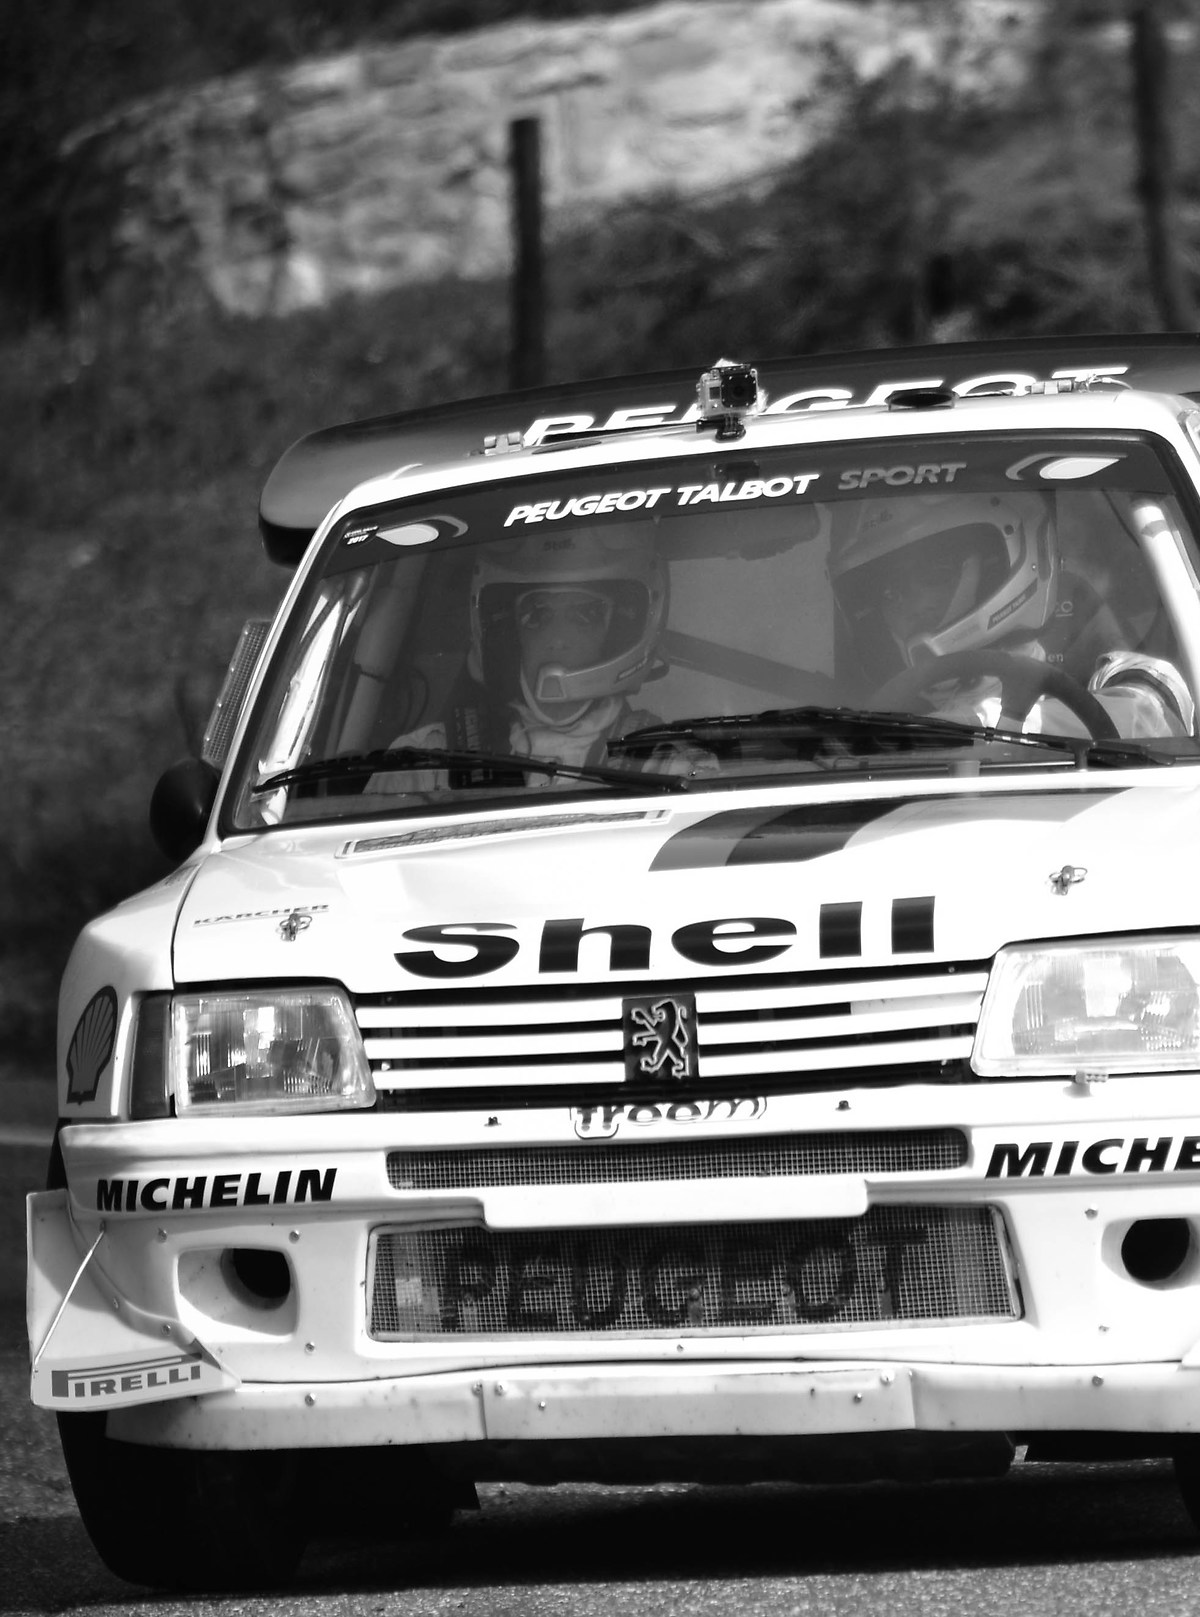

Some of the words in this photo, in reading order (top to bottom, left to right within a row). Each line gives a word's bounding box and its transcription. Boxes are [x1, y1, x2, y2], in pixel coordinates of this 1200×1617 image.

[522, 367, 1128, 446] PEGOT
[503, 487, 671, 527] PEUGEOT
[676, 474, 820, 506] TALBOT
[838, 463, 967, 490] SPORT
[394, 896, 934, 980] shell
[96, 1168, 337, 1212] MICHELIN
[438, 1226, 928, 1330] PEUGEOT
[51, 1356, 201, 1399] PIRELLI
